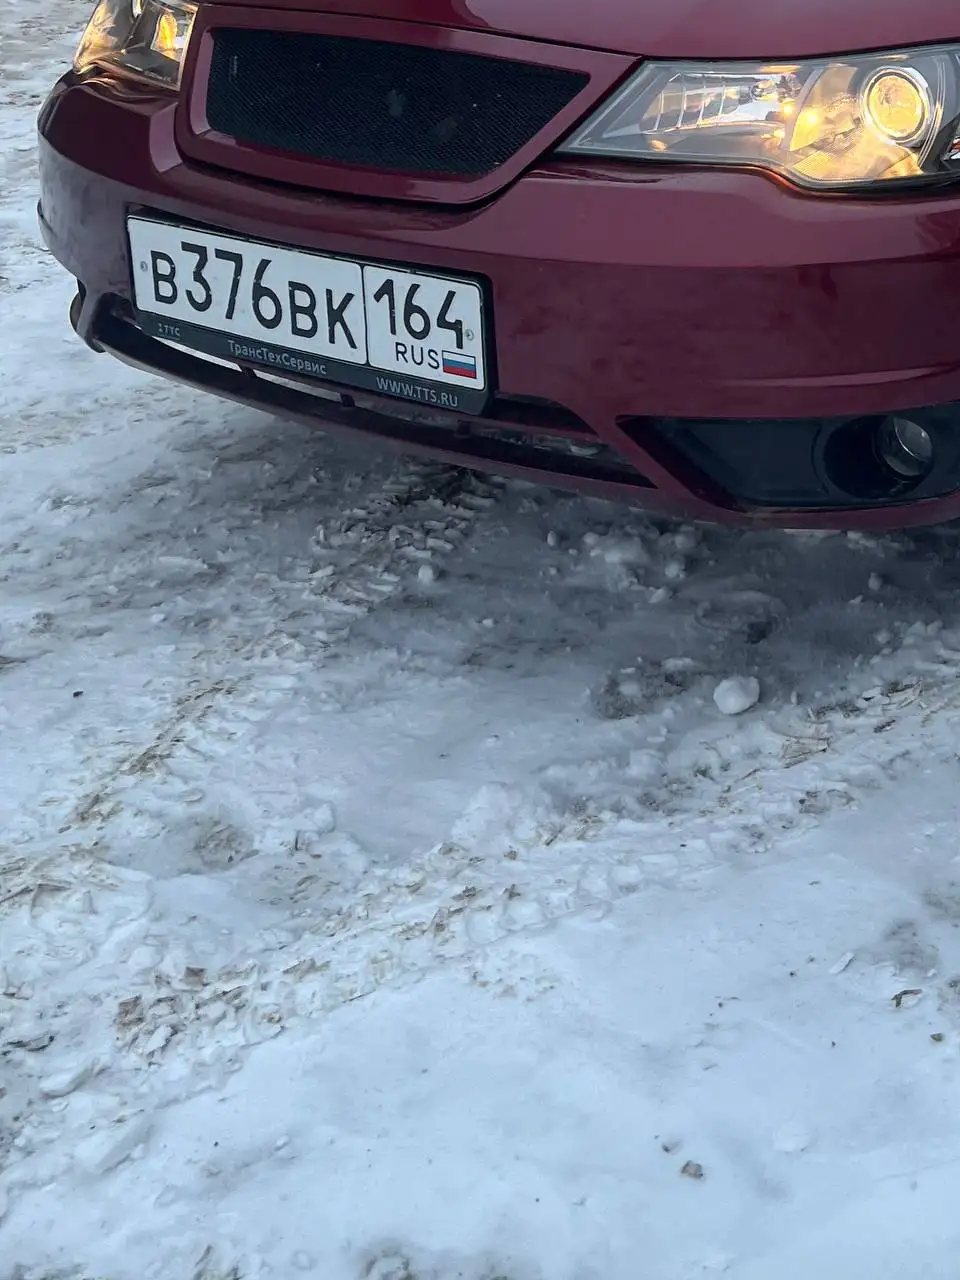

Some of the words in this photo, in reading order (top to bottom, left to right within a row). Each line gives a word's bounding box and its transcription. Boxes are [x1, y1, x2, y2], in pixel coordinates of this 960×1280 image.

[373, 278, 464, 350] 164
[227, 339, 328, 375] ТрансТехСервис
[395, 341, 440, 370] RUS
[375, 376, 459, 408] WWW.TTS.RU
